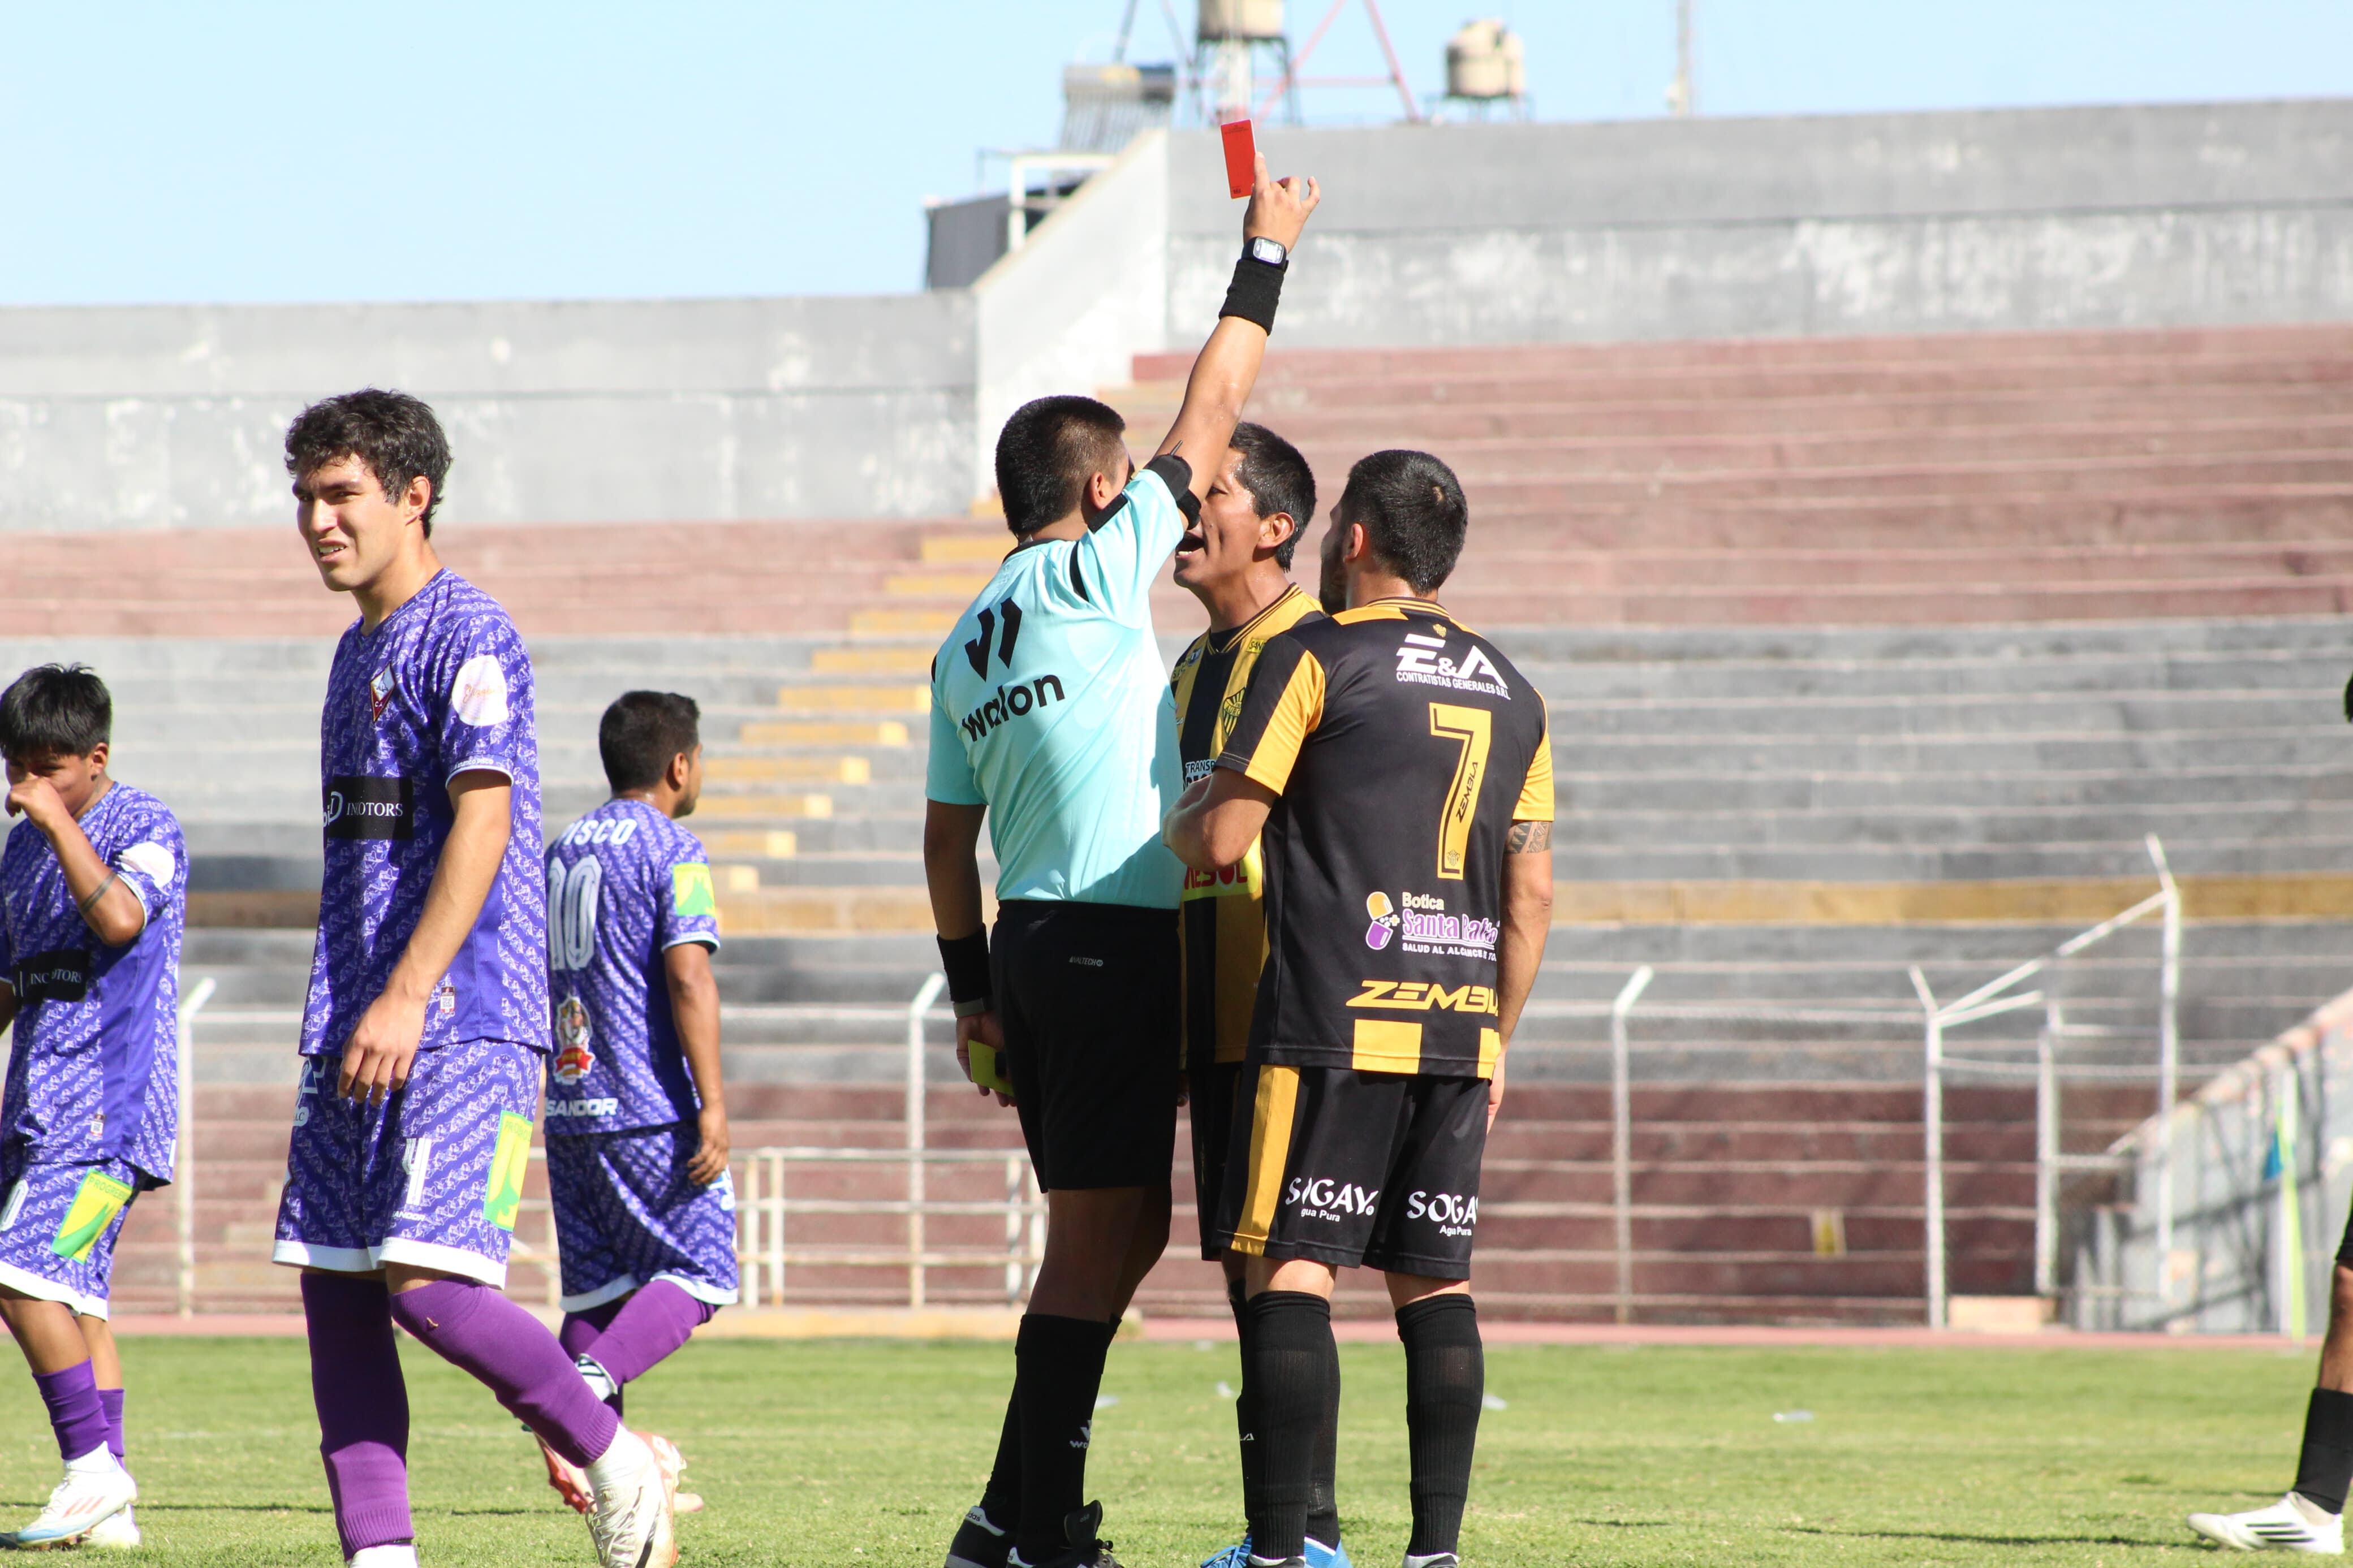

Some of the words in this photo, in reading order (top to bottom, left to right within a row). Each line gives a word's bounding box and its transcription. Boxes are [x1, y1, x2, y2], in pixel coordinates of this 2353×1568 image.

[1396, 633, 1509, 689] E&A
[1396, 671, 1451, 688] CONTRATISTAS
[1452, 679, 1495, 695] GENERALES
[962, 675, 1065, 742] walon
[1429, 702, 1492, 880] 7
[1456, 761, 1478, 823] ZEMBLA
[548, 854, 602, 971] 10
[1402, 891, 1445, 910] Botica
[1402, 908, 1459, 939] Santa
[1402, 942, 1430, 953] SALUD
[1432, 945, 1445, 954] AL
[1346, 980, 1498, 1017] ZEMBL
[402, 1138, 432, 1206] 4
[1301, 1208, 1317, 1217] gua
[1319, 1209, 1341, 1223] Pura
[1406, 1190, 1478, 1225] SOGA
[1439, 1225, 1456, 1237] Agua
[1456, 1226, 1472, 1236] Pura
